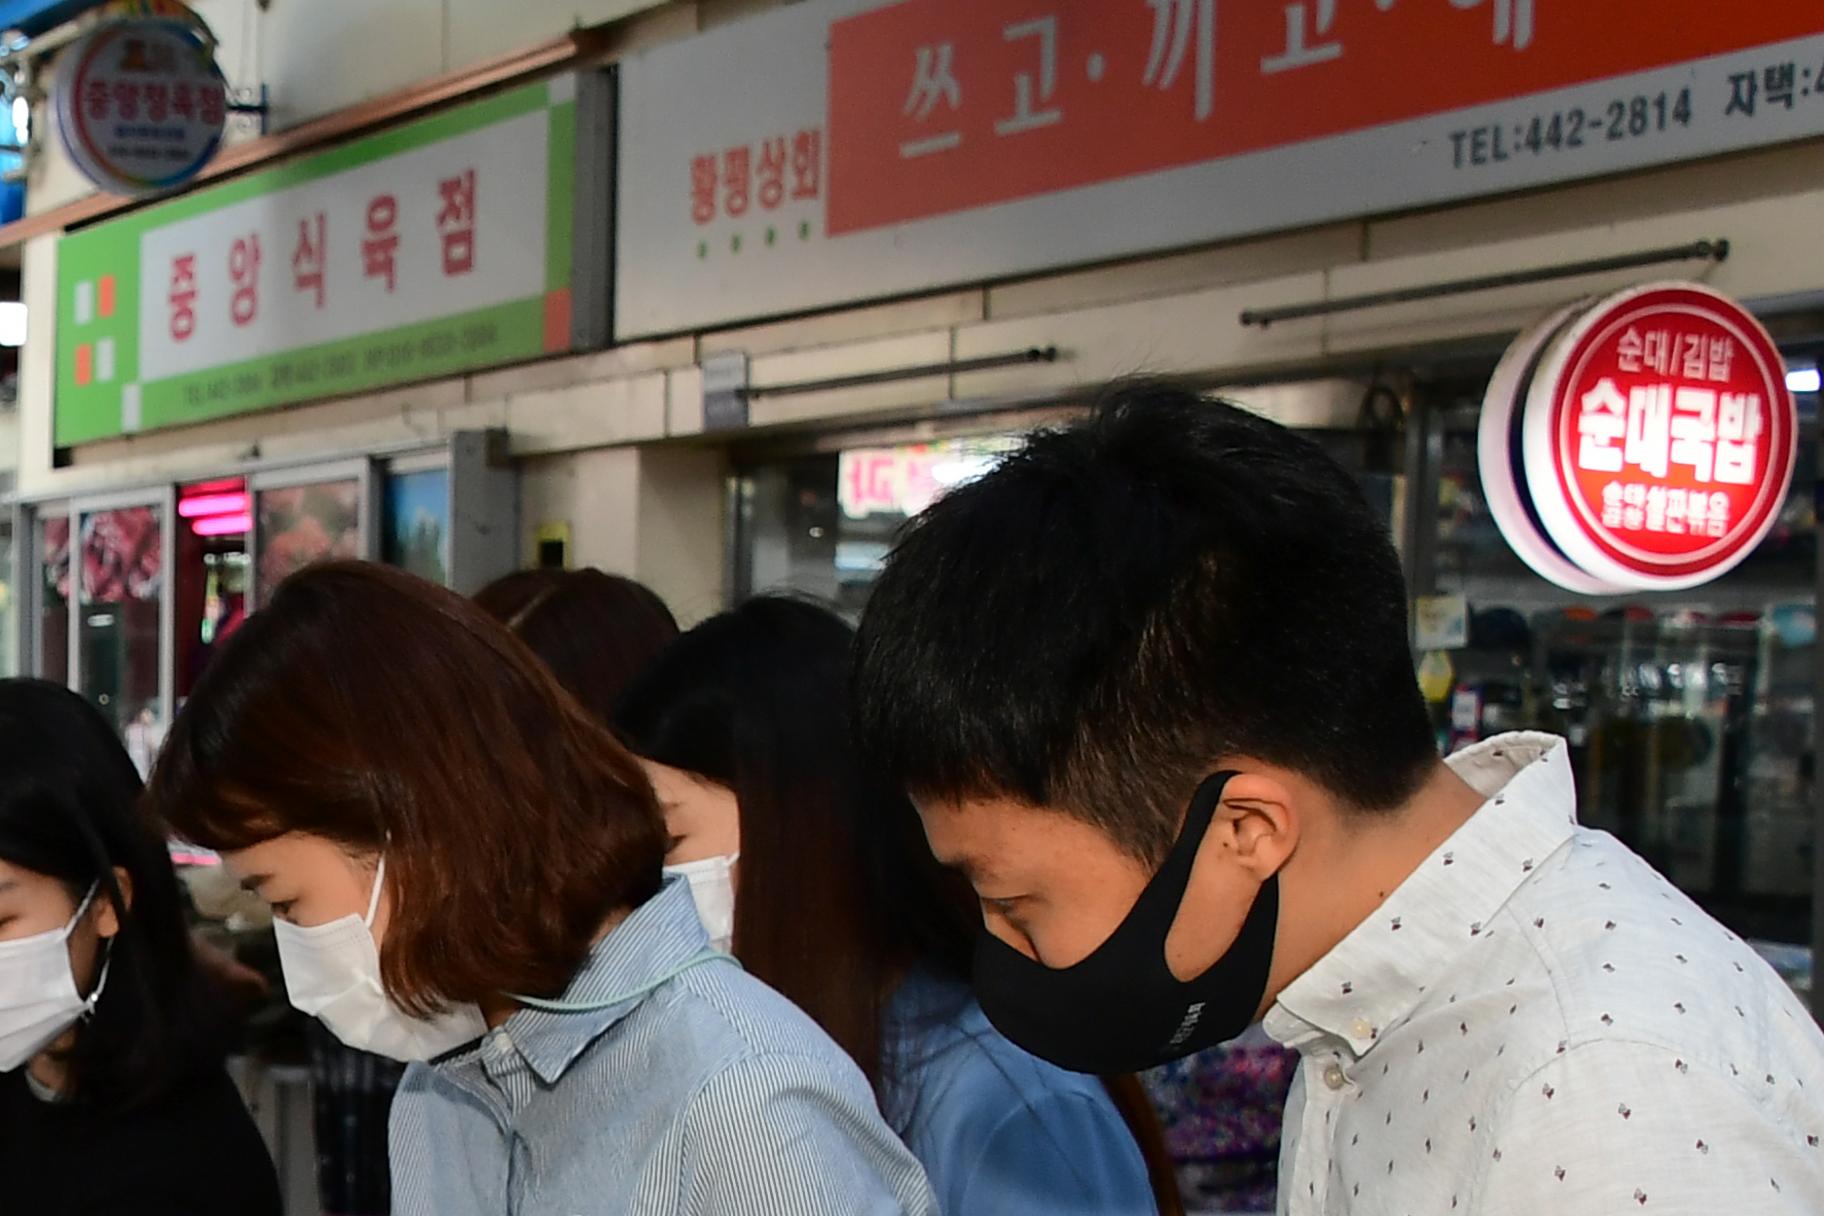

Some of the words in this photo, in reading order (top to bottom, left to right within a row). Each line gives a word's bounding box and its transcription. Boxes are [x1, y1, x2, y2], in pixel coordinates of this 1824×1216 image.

[1448, 87, 1692, 168] TEL:442-2814
[168, 168, 475, 343] 중앙식육점
[1617, 327, 1734, 382] 순대/김밥
[1578, 377, 1763, 485] 순대국밥
